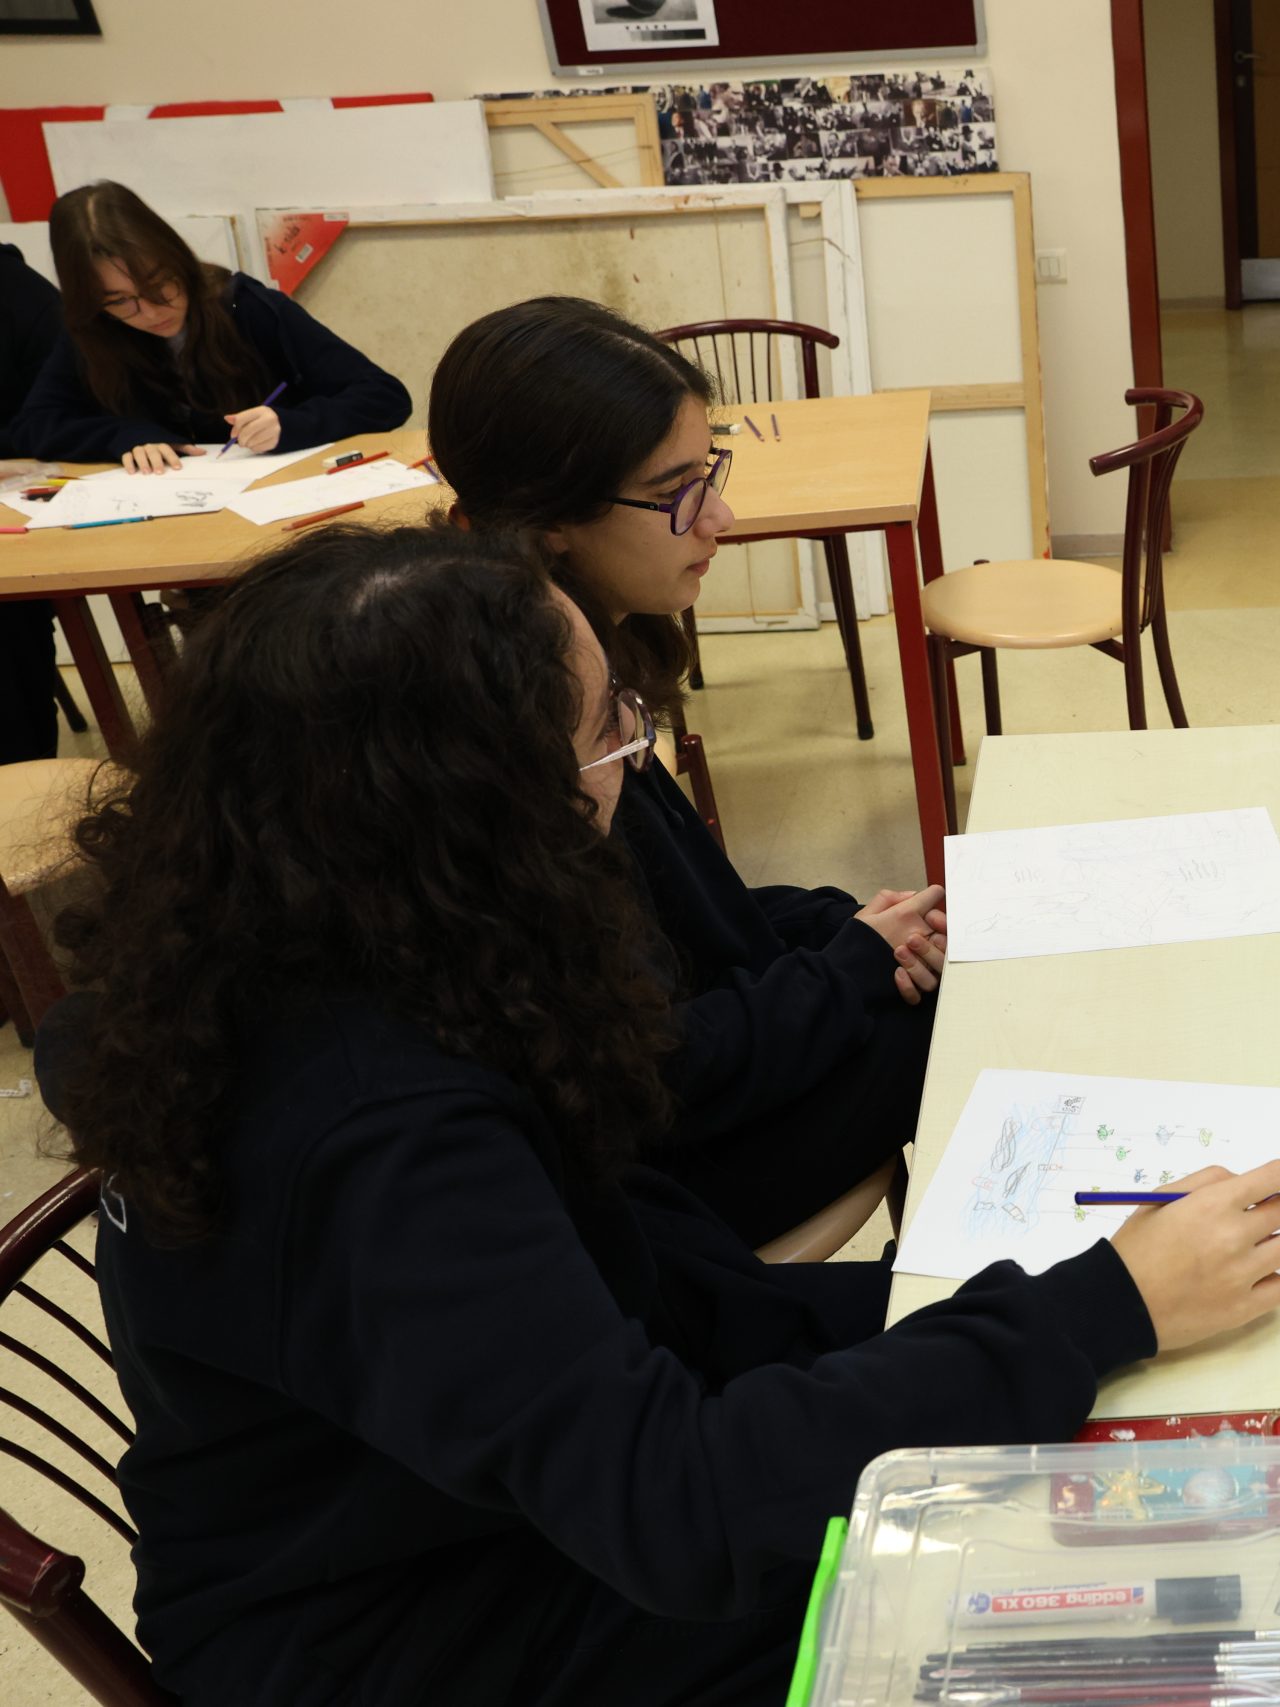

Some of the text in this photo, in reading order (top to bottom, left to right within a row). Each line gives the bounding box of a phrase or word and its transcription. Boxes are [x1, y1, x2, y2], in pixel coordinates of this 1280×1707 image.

[997, 1598, 1019, 1610] XL
[1022, 1596, 1061, 1609] 360
[1066, 1591, 1126, 1605] edding
